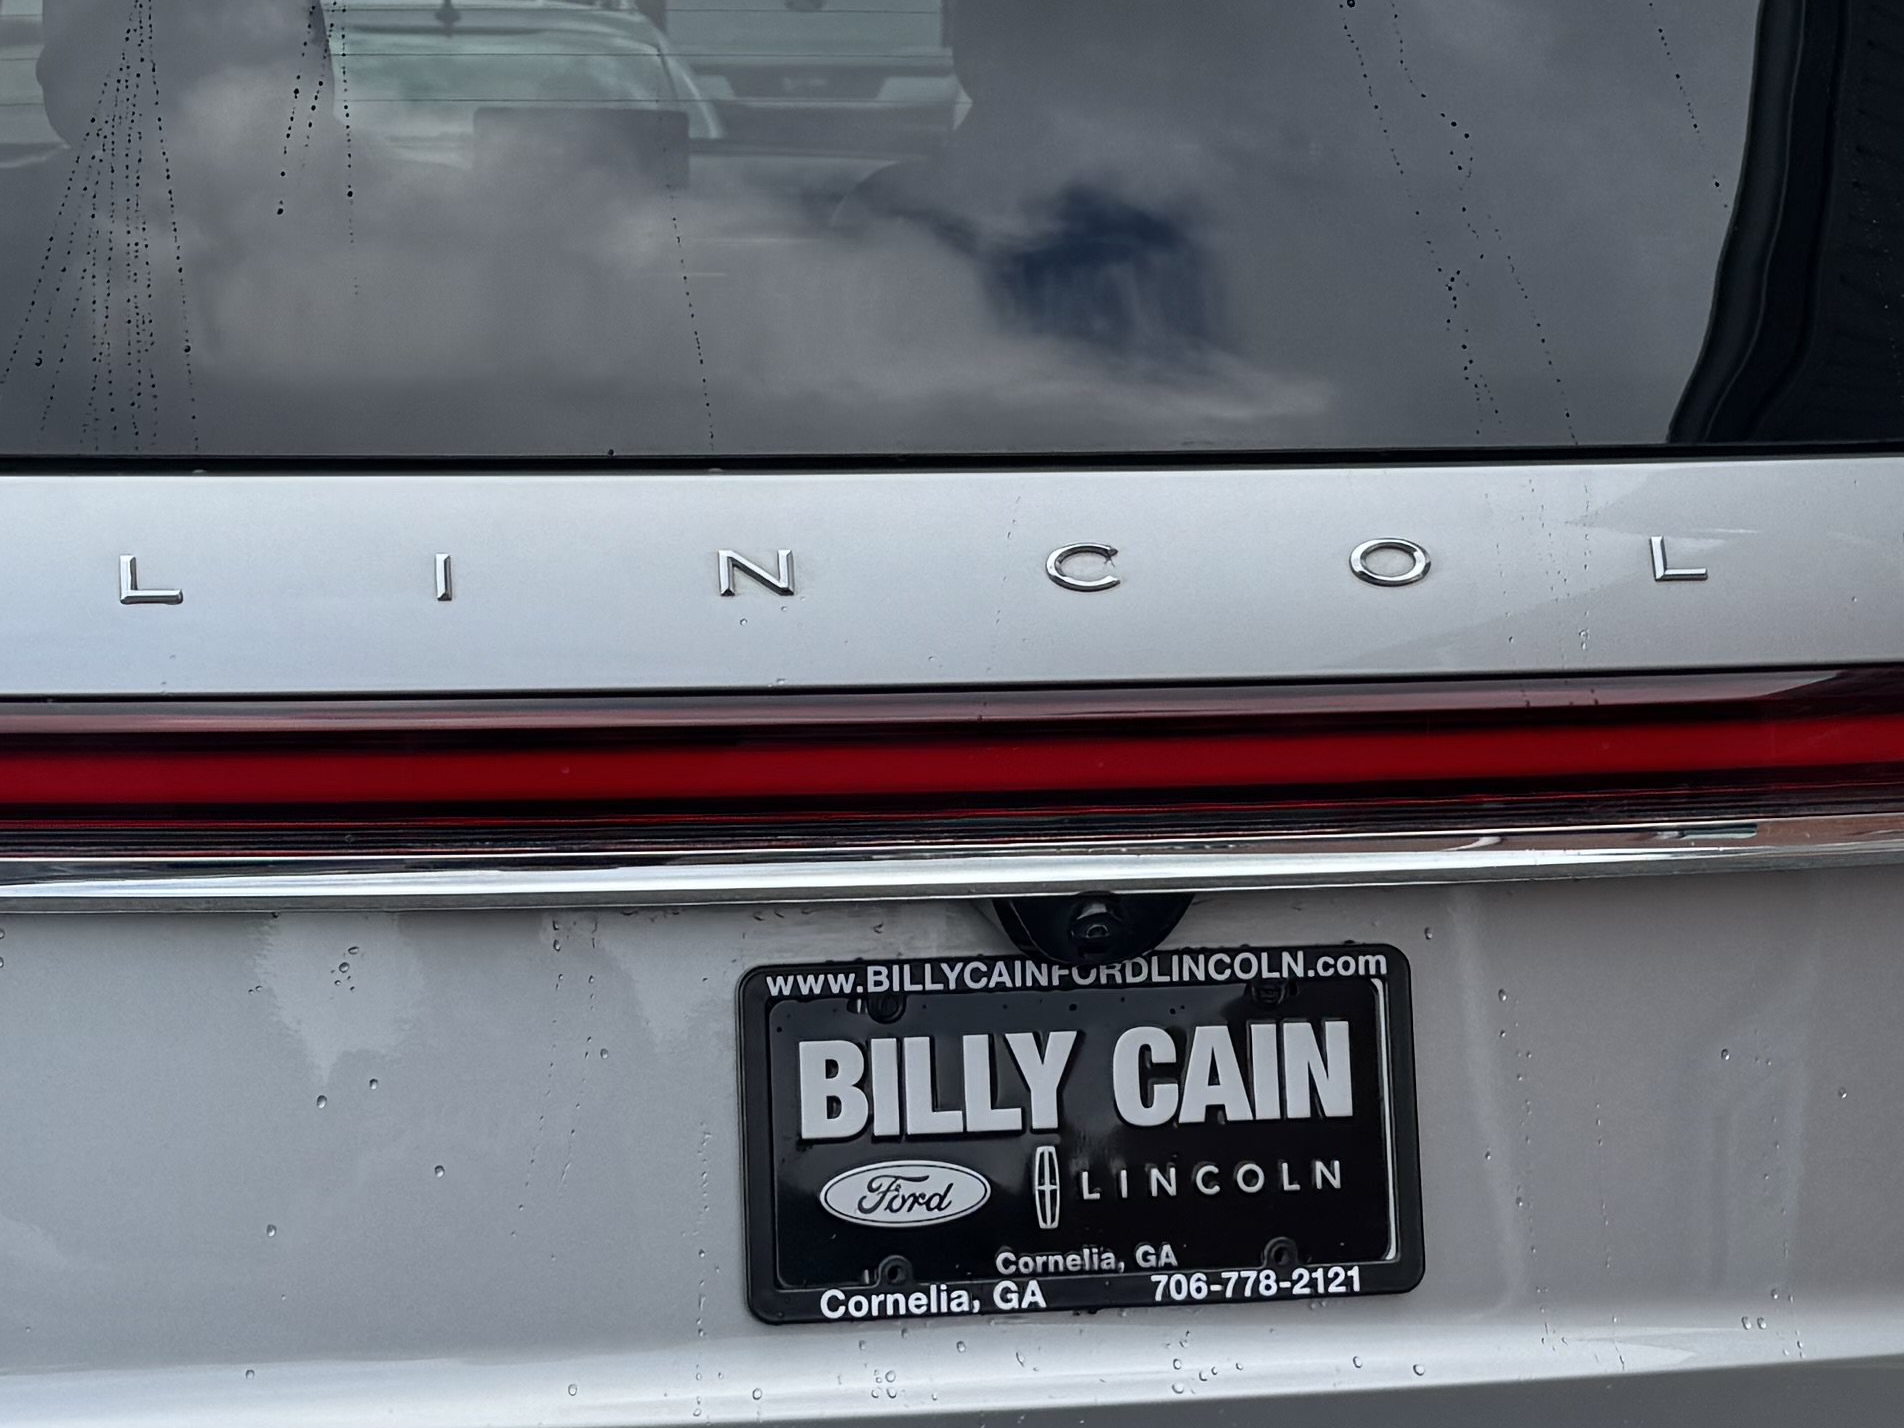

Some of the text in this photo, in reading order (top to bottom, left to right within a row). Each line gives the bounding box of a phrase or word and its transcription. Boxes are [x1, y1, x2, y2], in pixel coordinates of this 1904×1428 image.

[798, 1020, 1354, 1140] BILLY CAIN
[1081, 1159, 1342, 1201] LINCOLN
[995, 1243, 1178, 1276] Cornelia, GA
[819, 1280, 1048, 1321] Cornelia, GA
[1150, 1265, 1362, 1302] 706-778-2121
